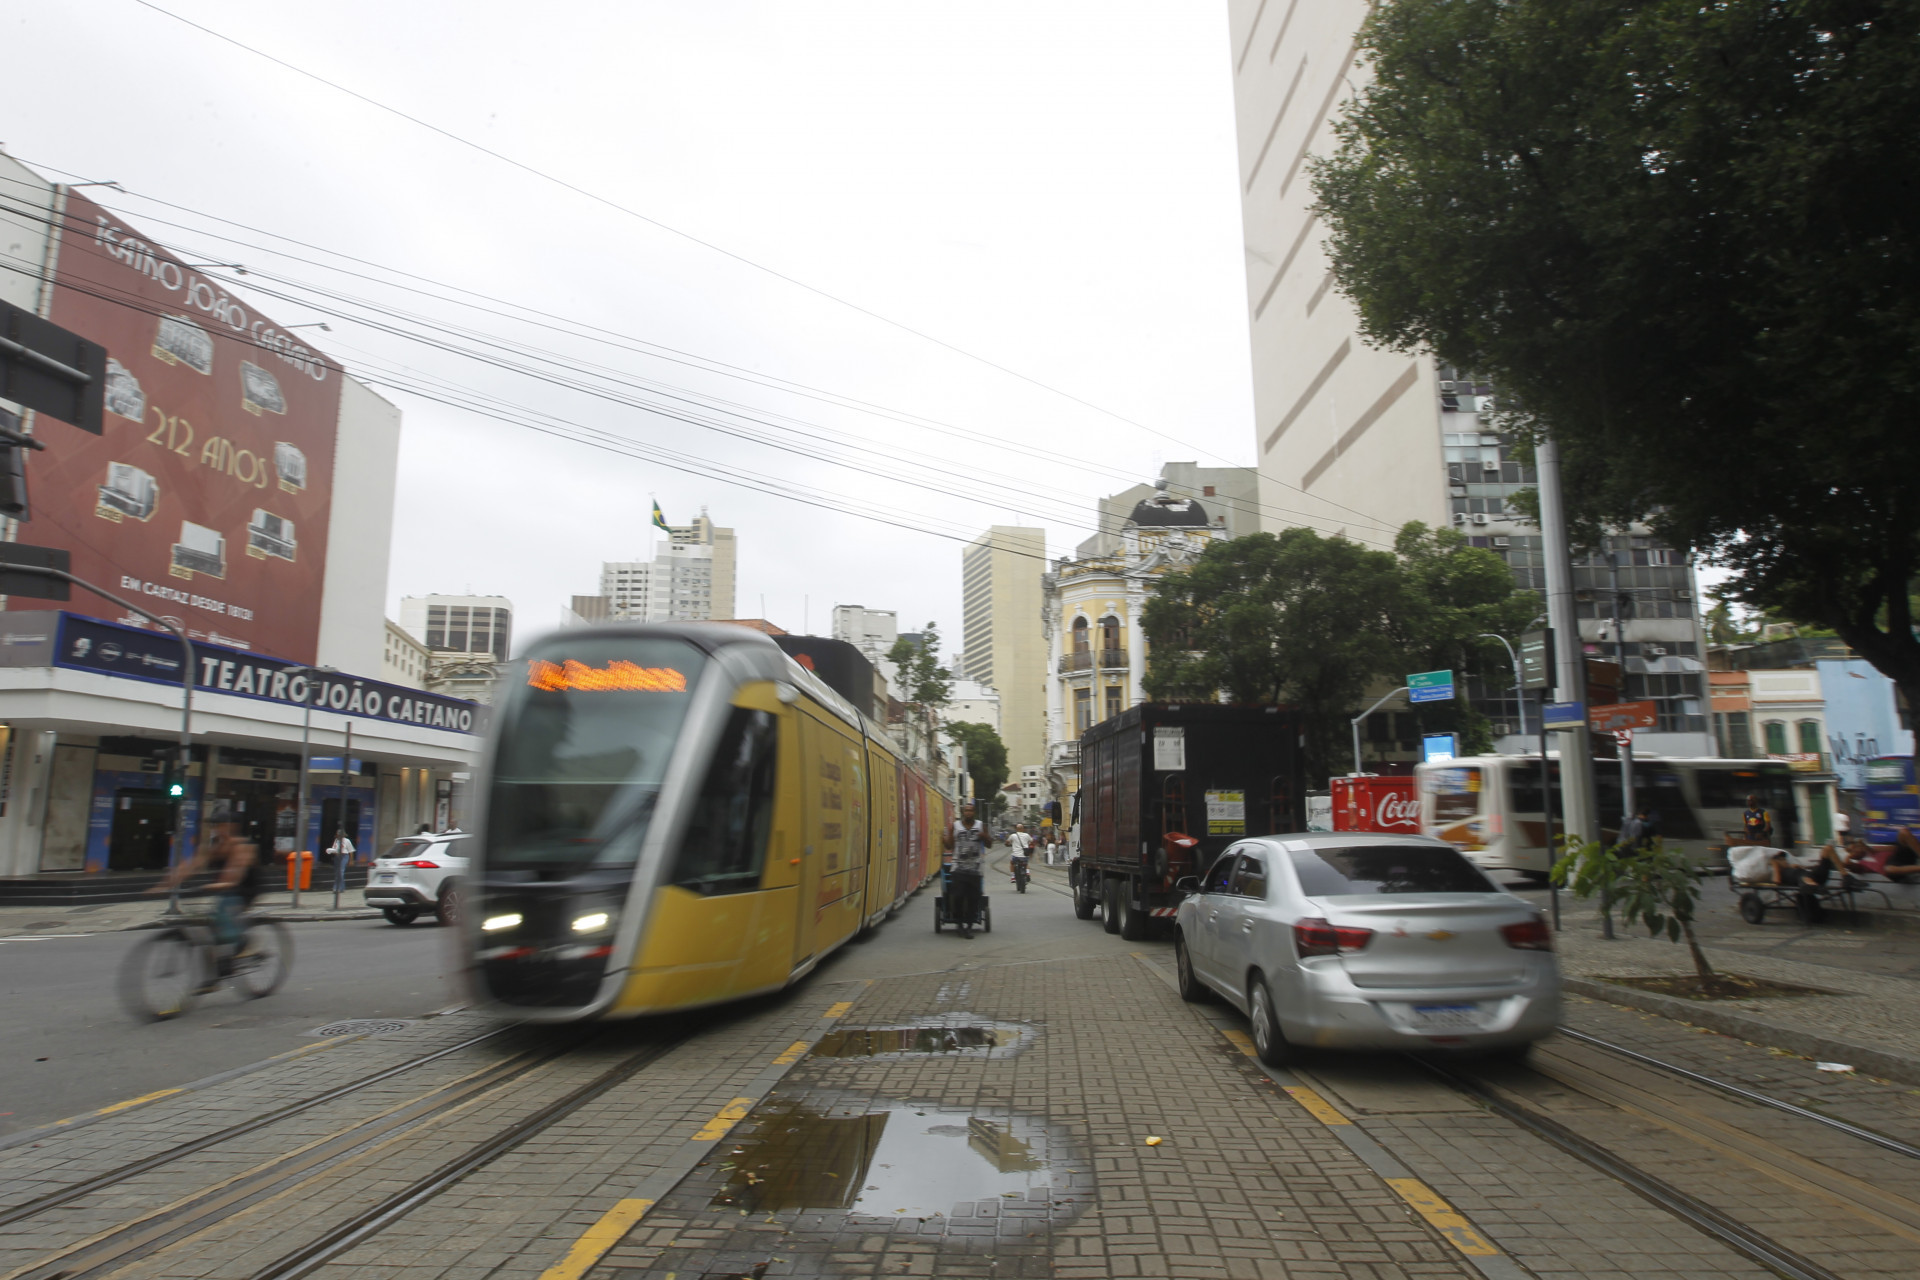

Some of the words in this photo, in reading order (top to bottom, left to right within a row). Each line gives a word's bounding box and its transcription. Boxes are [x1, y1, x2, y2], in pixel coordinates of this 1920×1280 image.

[95, 215, 182, 291] TEATRO
[184, 276, 248, 332] JOÃO
[251, 320, 327, 381] CAETANO
[146, 406, 194, 457] 212
[201, 436, 268, 489] ANOS
[121, 575, 141, 591] EM
[143, 582, 190, 605] CARTAZ
[190, 594, 227, 614] DESDE
[201, 656, 311, 703] TEATRO
[315, 680, 382, 716] JOÃO
[387, 695, 472, 731] CAETANO
